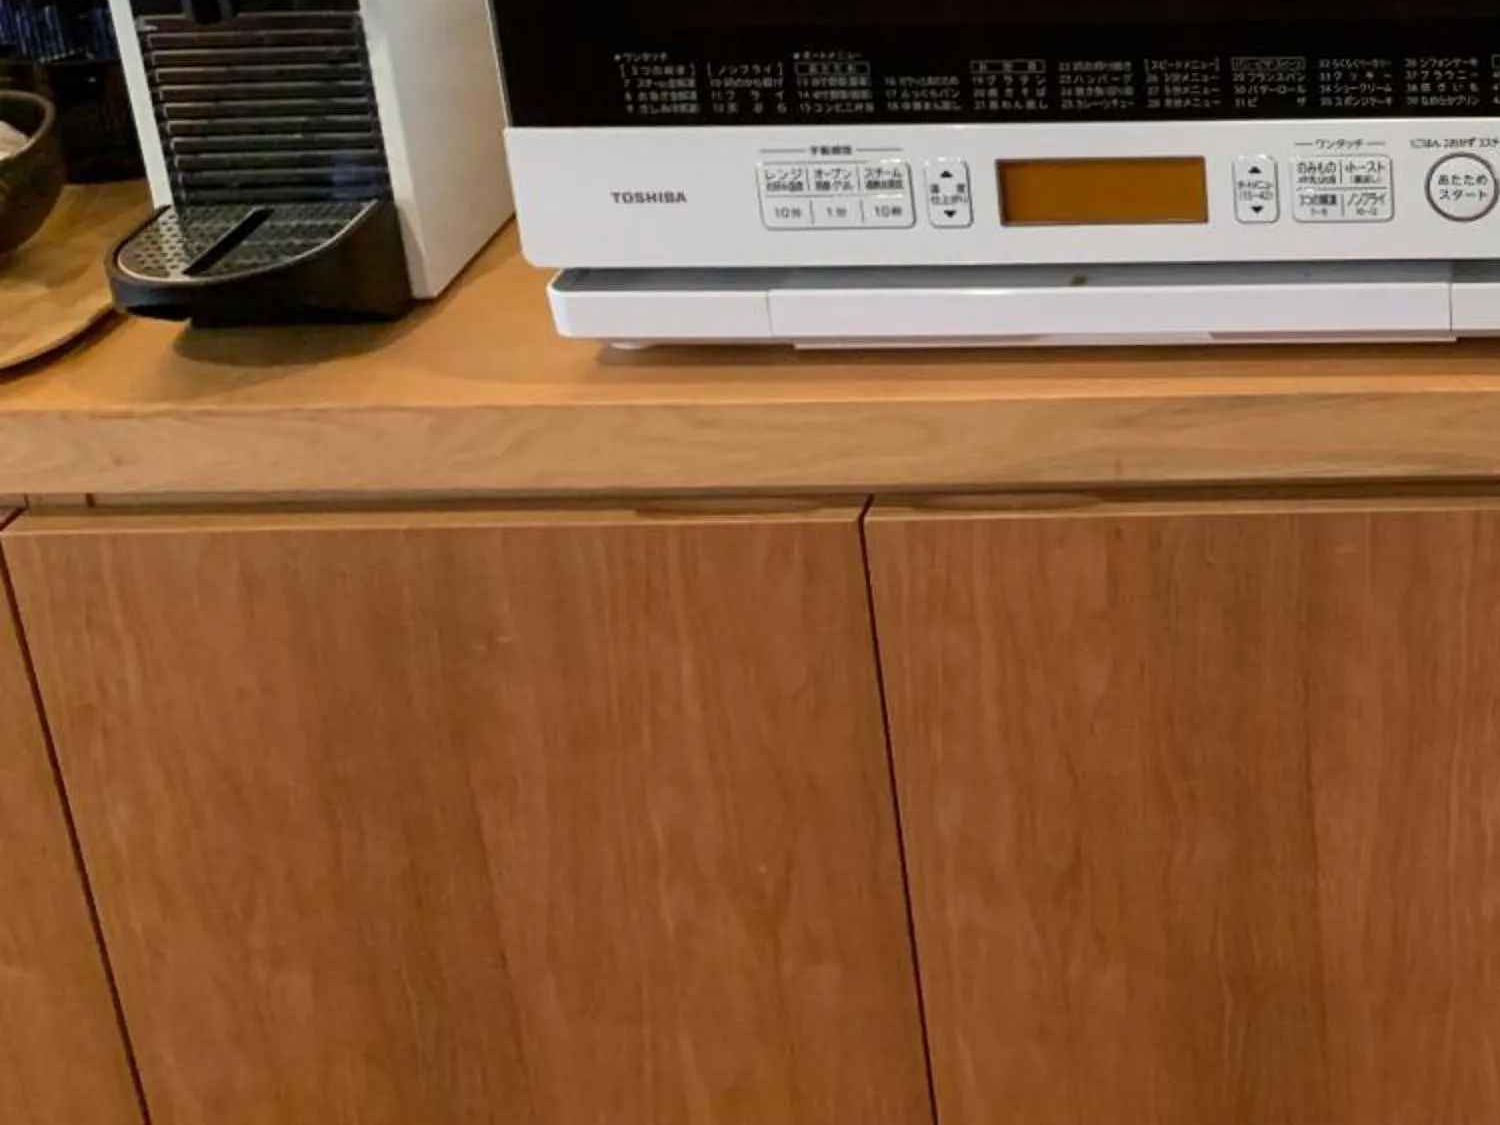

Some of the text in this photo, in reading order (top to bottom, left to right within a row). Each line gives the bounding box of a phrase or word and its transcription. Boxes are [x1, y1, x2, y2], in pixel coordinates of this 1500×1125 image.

[1438, 175, 1489, 187] あたため
[611, 190, 687, 204] TOSHIBA
[1439, 189, 1488, 201] スタート
